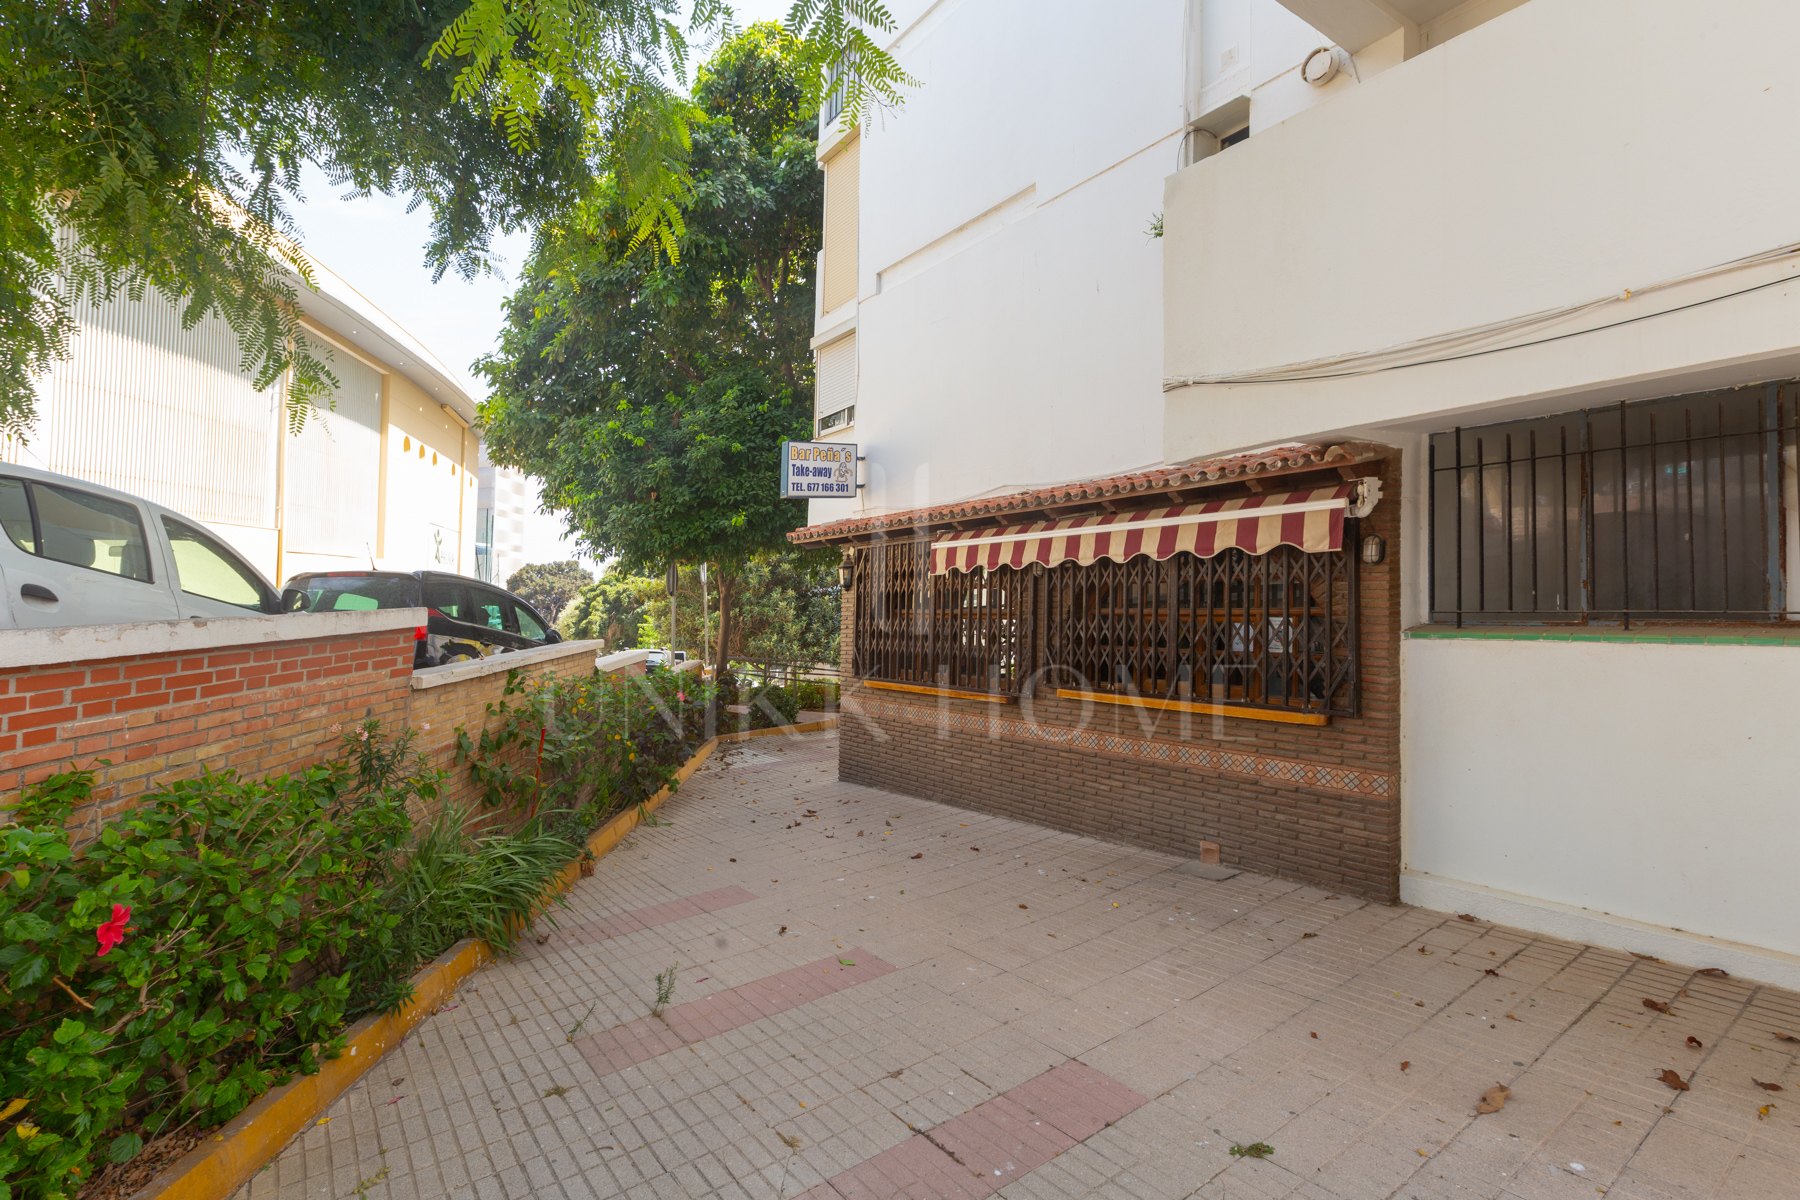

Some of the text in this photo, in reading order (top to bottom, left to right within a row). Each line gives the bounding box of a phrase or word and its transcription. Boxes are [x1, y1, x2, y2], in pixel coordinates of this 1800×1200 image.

[791, 446, 811, 460] Bar
[792, 464, 832, 478] Take-away
[792, 482, 849, 492] TEL. 677 166 301
